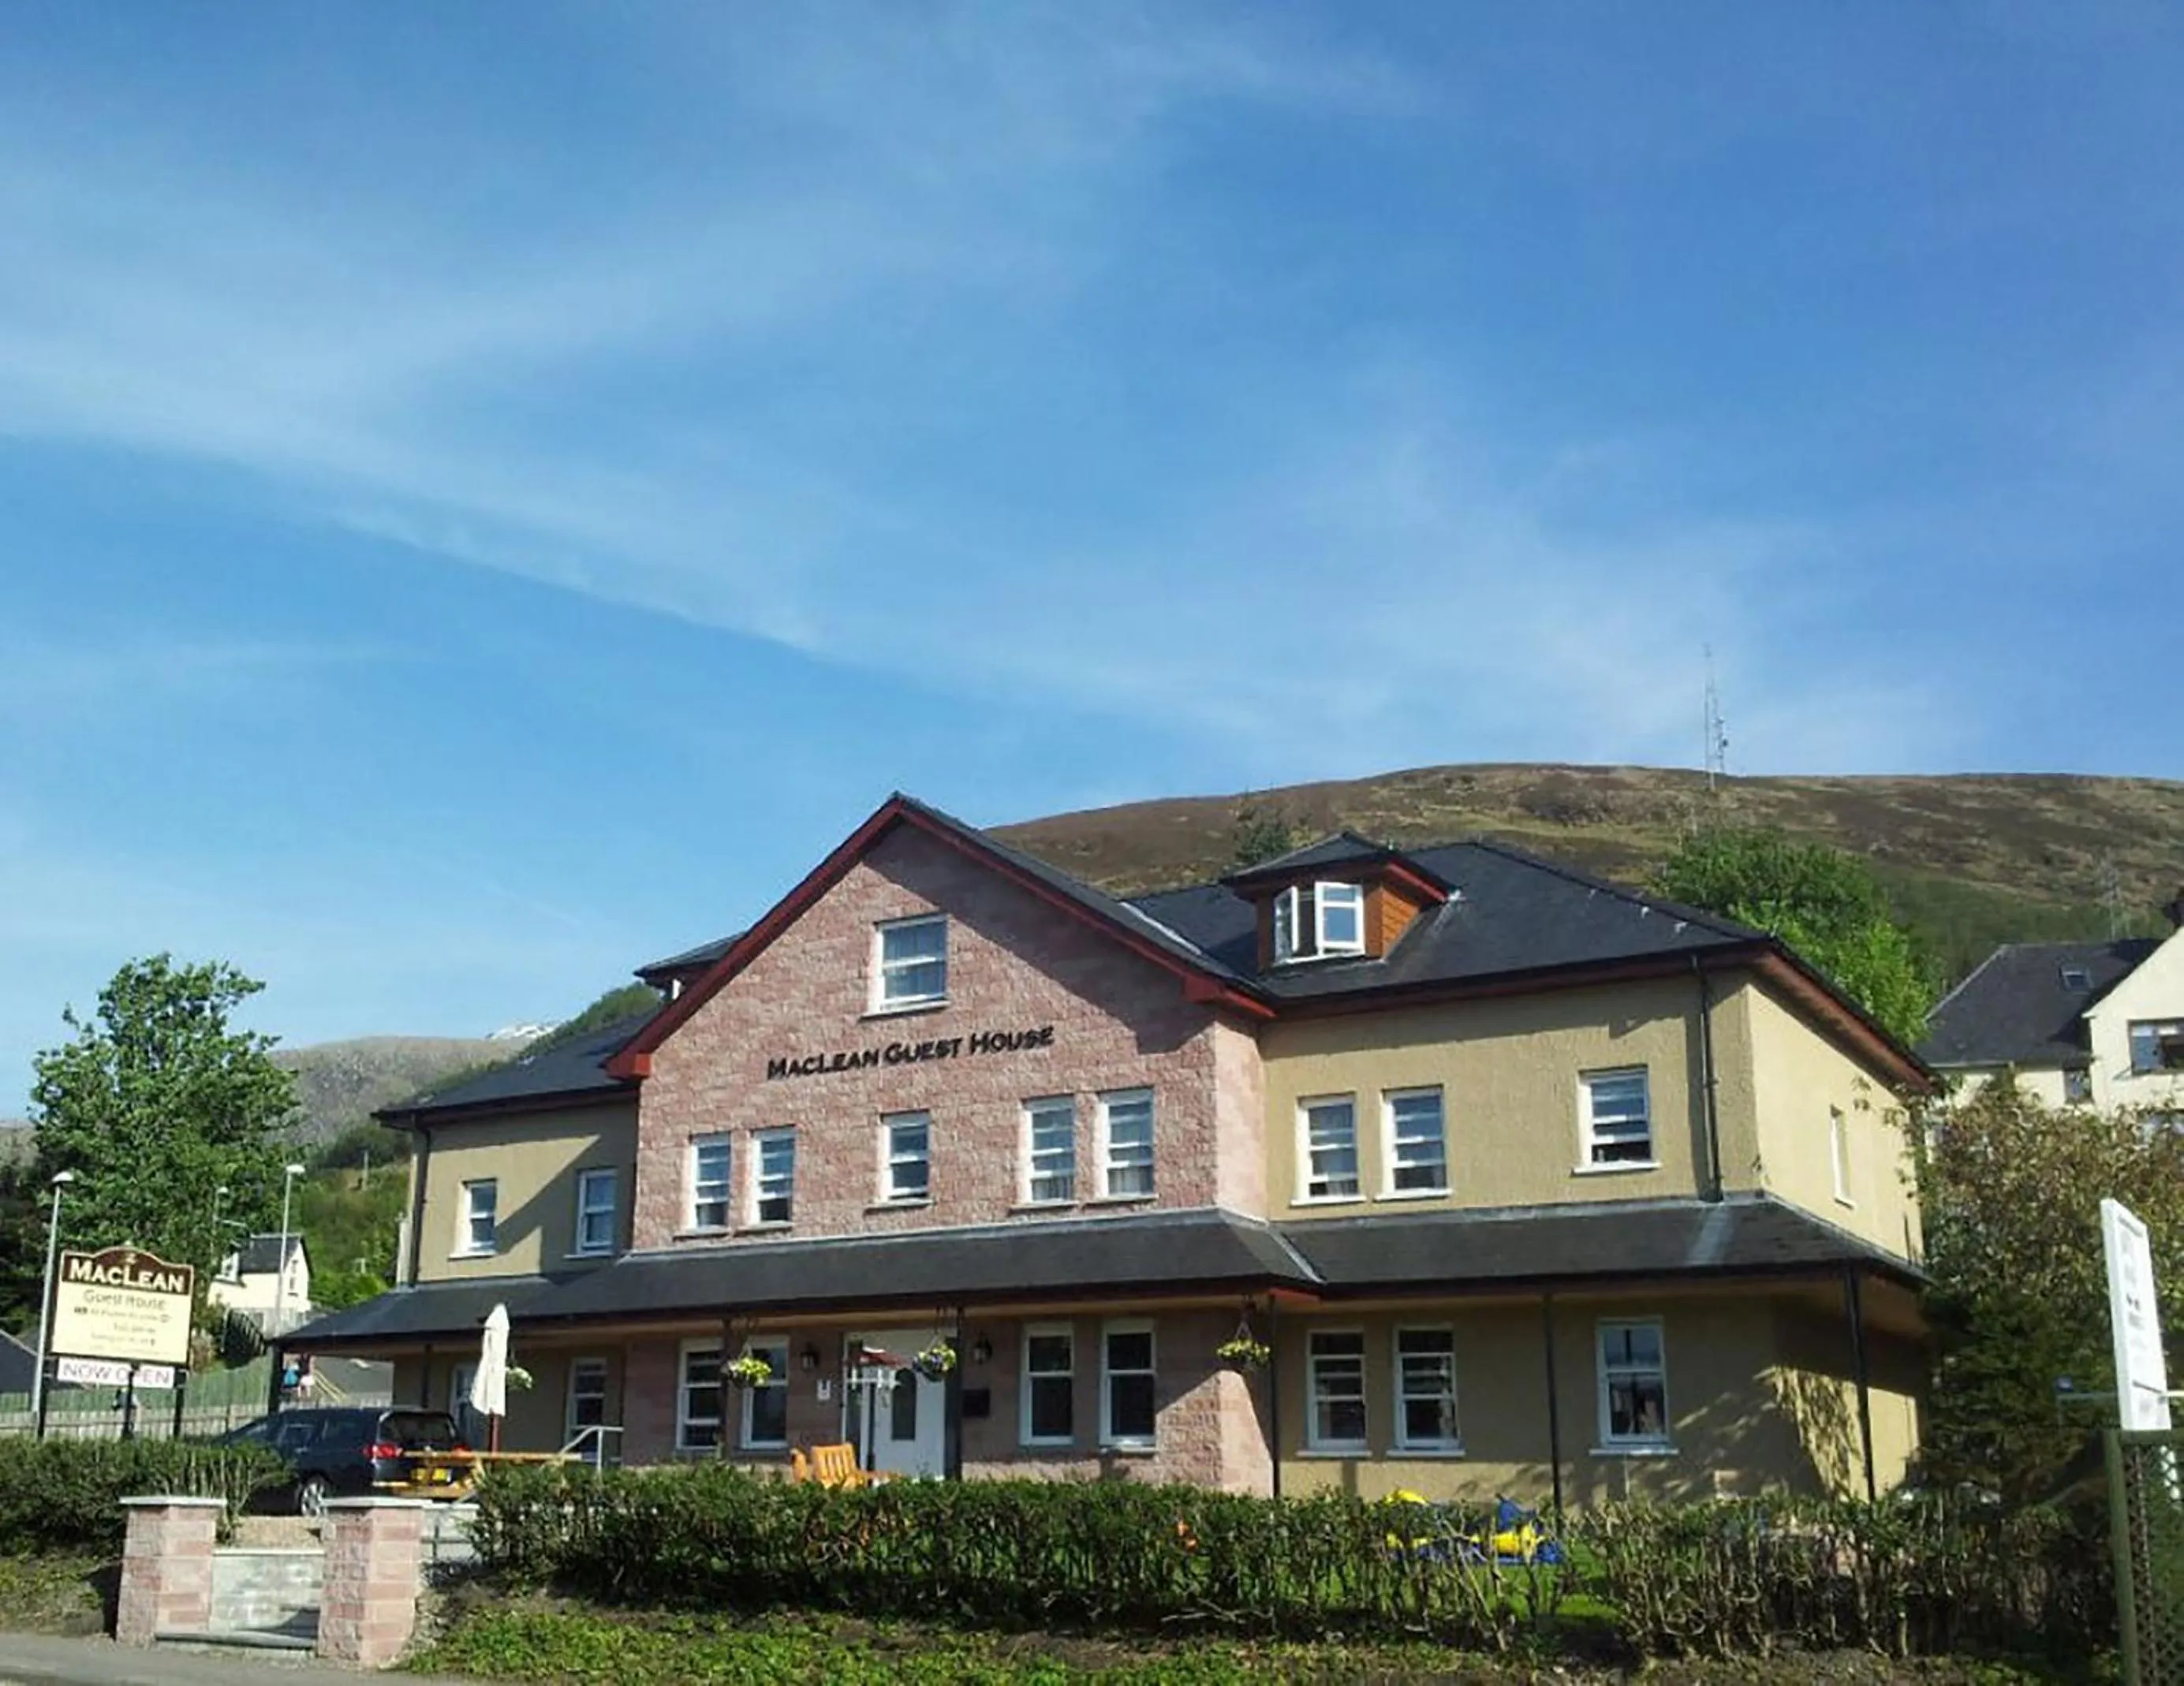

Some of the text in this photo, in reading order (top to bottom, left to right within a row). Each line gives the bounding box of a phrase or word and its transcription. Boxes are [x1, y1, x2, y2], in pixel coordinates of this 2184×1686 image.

[884, 1038, 962, 1064] GUEST
[969, 1026, 1055, 1054] HOUSE
[63, 1363, 112, 1378] NOW
